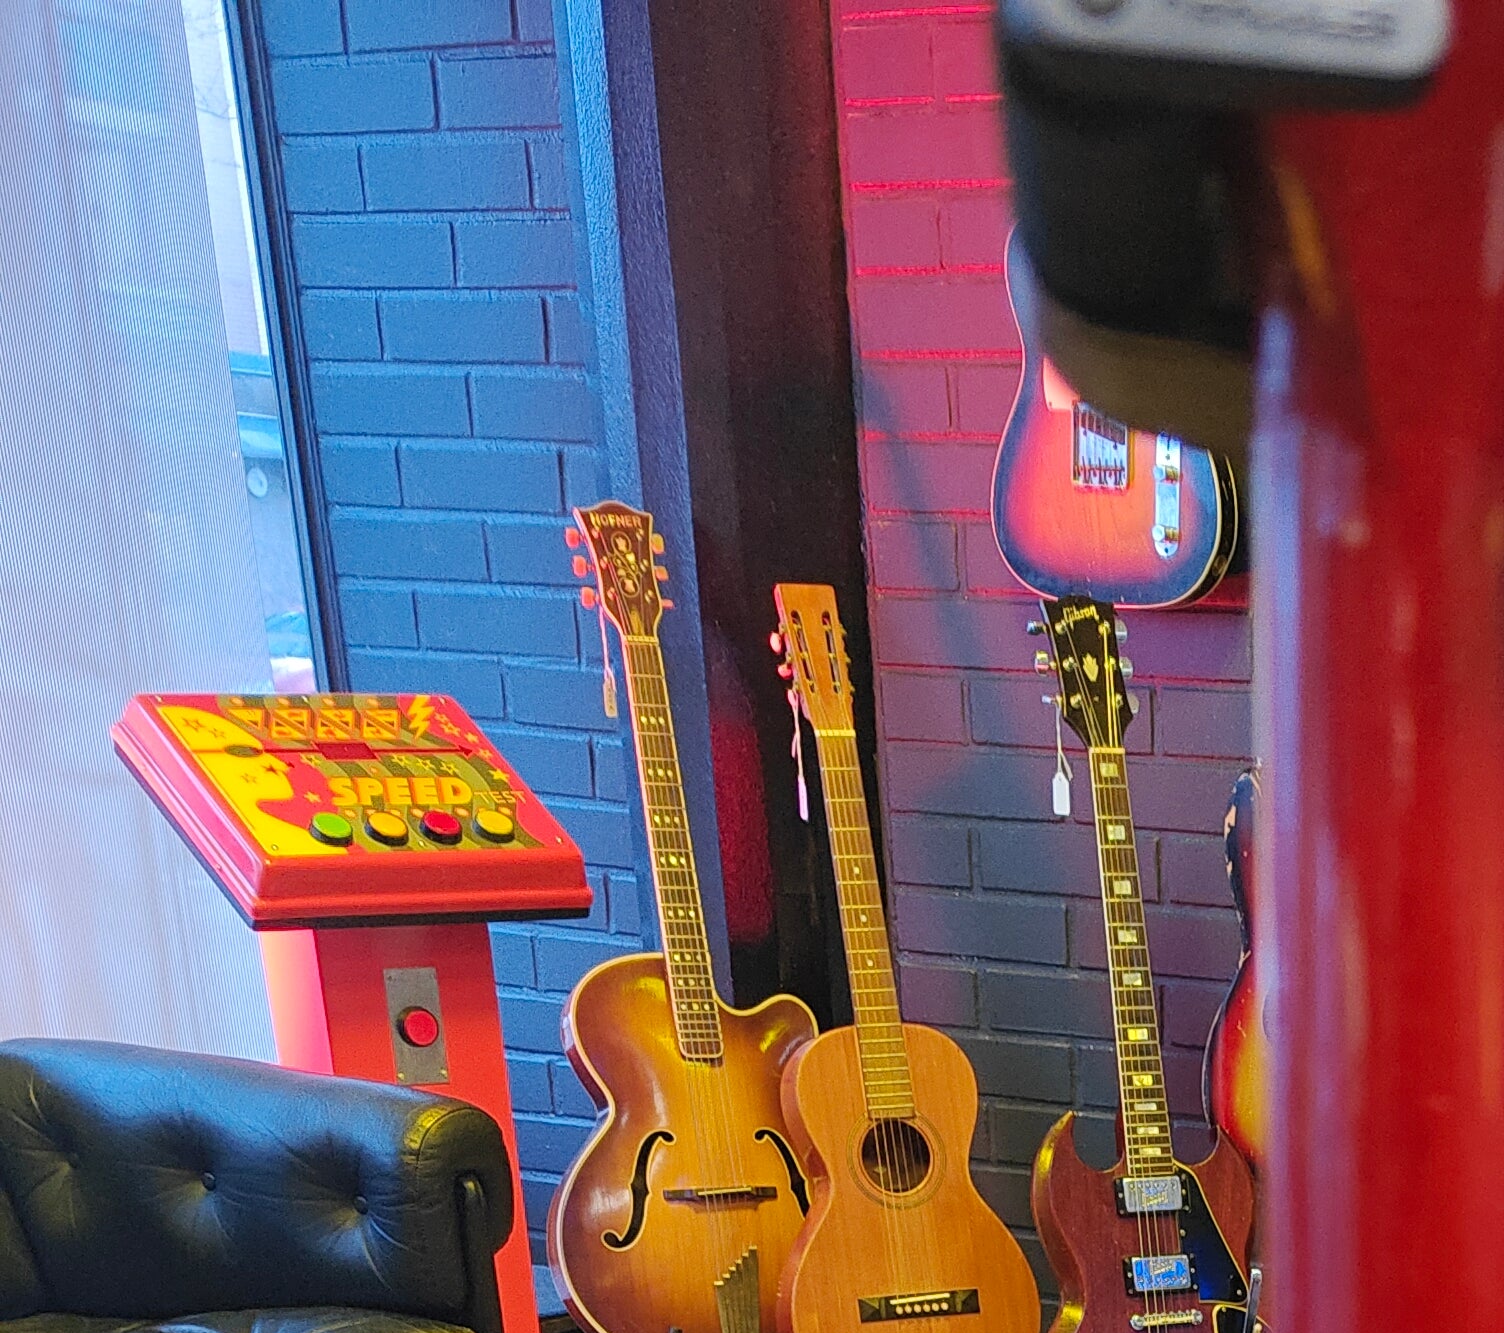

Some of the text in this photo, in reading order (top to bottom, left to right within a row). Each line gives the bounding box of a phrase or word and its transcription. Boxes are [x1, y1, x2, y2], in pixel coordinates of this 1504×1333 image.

[1062, 603, 1099, 623] Gibson
[328, 776, 527, 807] SPEED TEST
